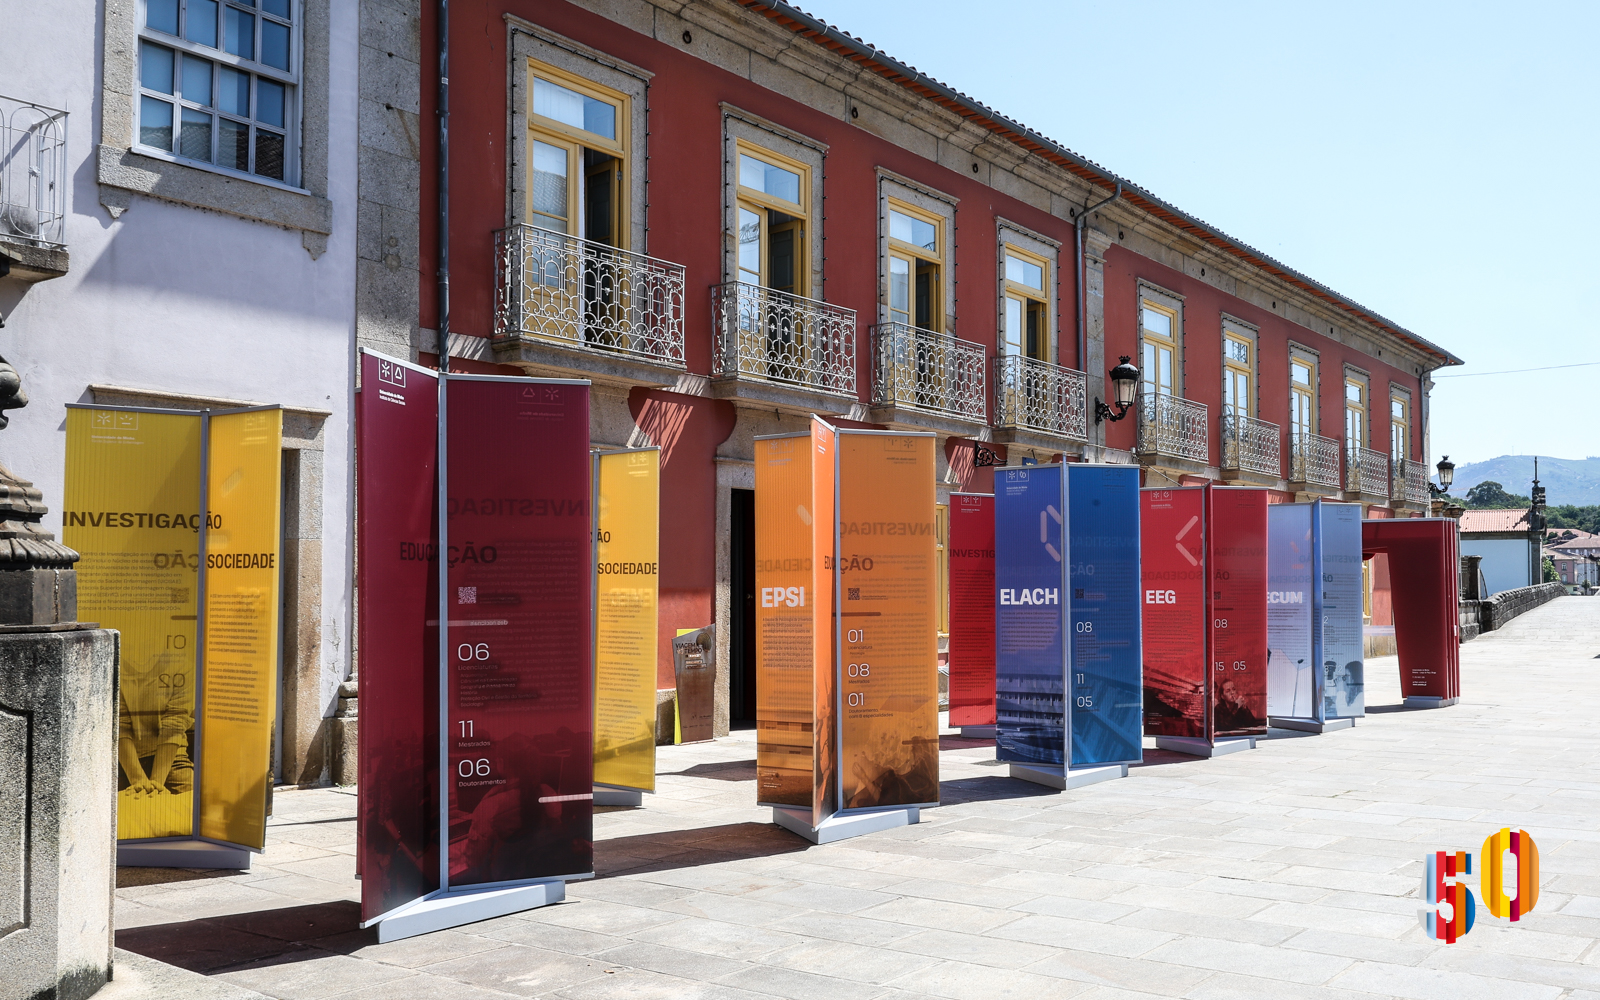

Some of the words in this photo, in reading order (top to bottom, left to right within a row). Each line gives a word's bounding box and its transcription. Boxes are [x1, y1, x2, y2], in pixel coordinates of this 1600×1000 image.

[63, 511, 222, 533] INVESTIGAÇÃO
[950, 549, 995, 558] INVESTIG
[207, 553, 274, 569] SOCIEDADE
[597, 562, 658, 574] SOCIEDADE
[762, 586, 804, 608] EPSI
[1000, 588, 1058, 606] ELACH
[1146, 590, 1176, 604] EEG
[1267, 592, 1303, 604] CUM
[1076, 622, 1093, 632] 08
[1214, 618, 1228, 628] 08
[847, 629, 863, 643] 01
[458, 642, 490, 662] 06
[848, 663, 870, 678] 08
[1215, 661, 1225, 671] 15
[1233, 660, 1246, 671] 05
[1076, 674, 1084, 684] 11
[848, 692, 864, 707] 01
[1076, 696, 1093, 708] 05
[458, 720, 473, 738] 11
[458, 758, 491, 778] 06
[458, 779, 507, 787] Doutoramentos
